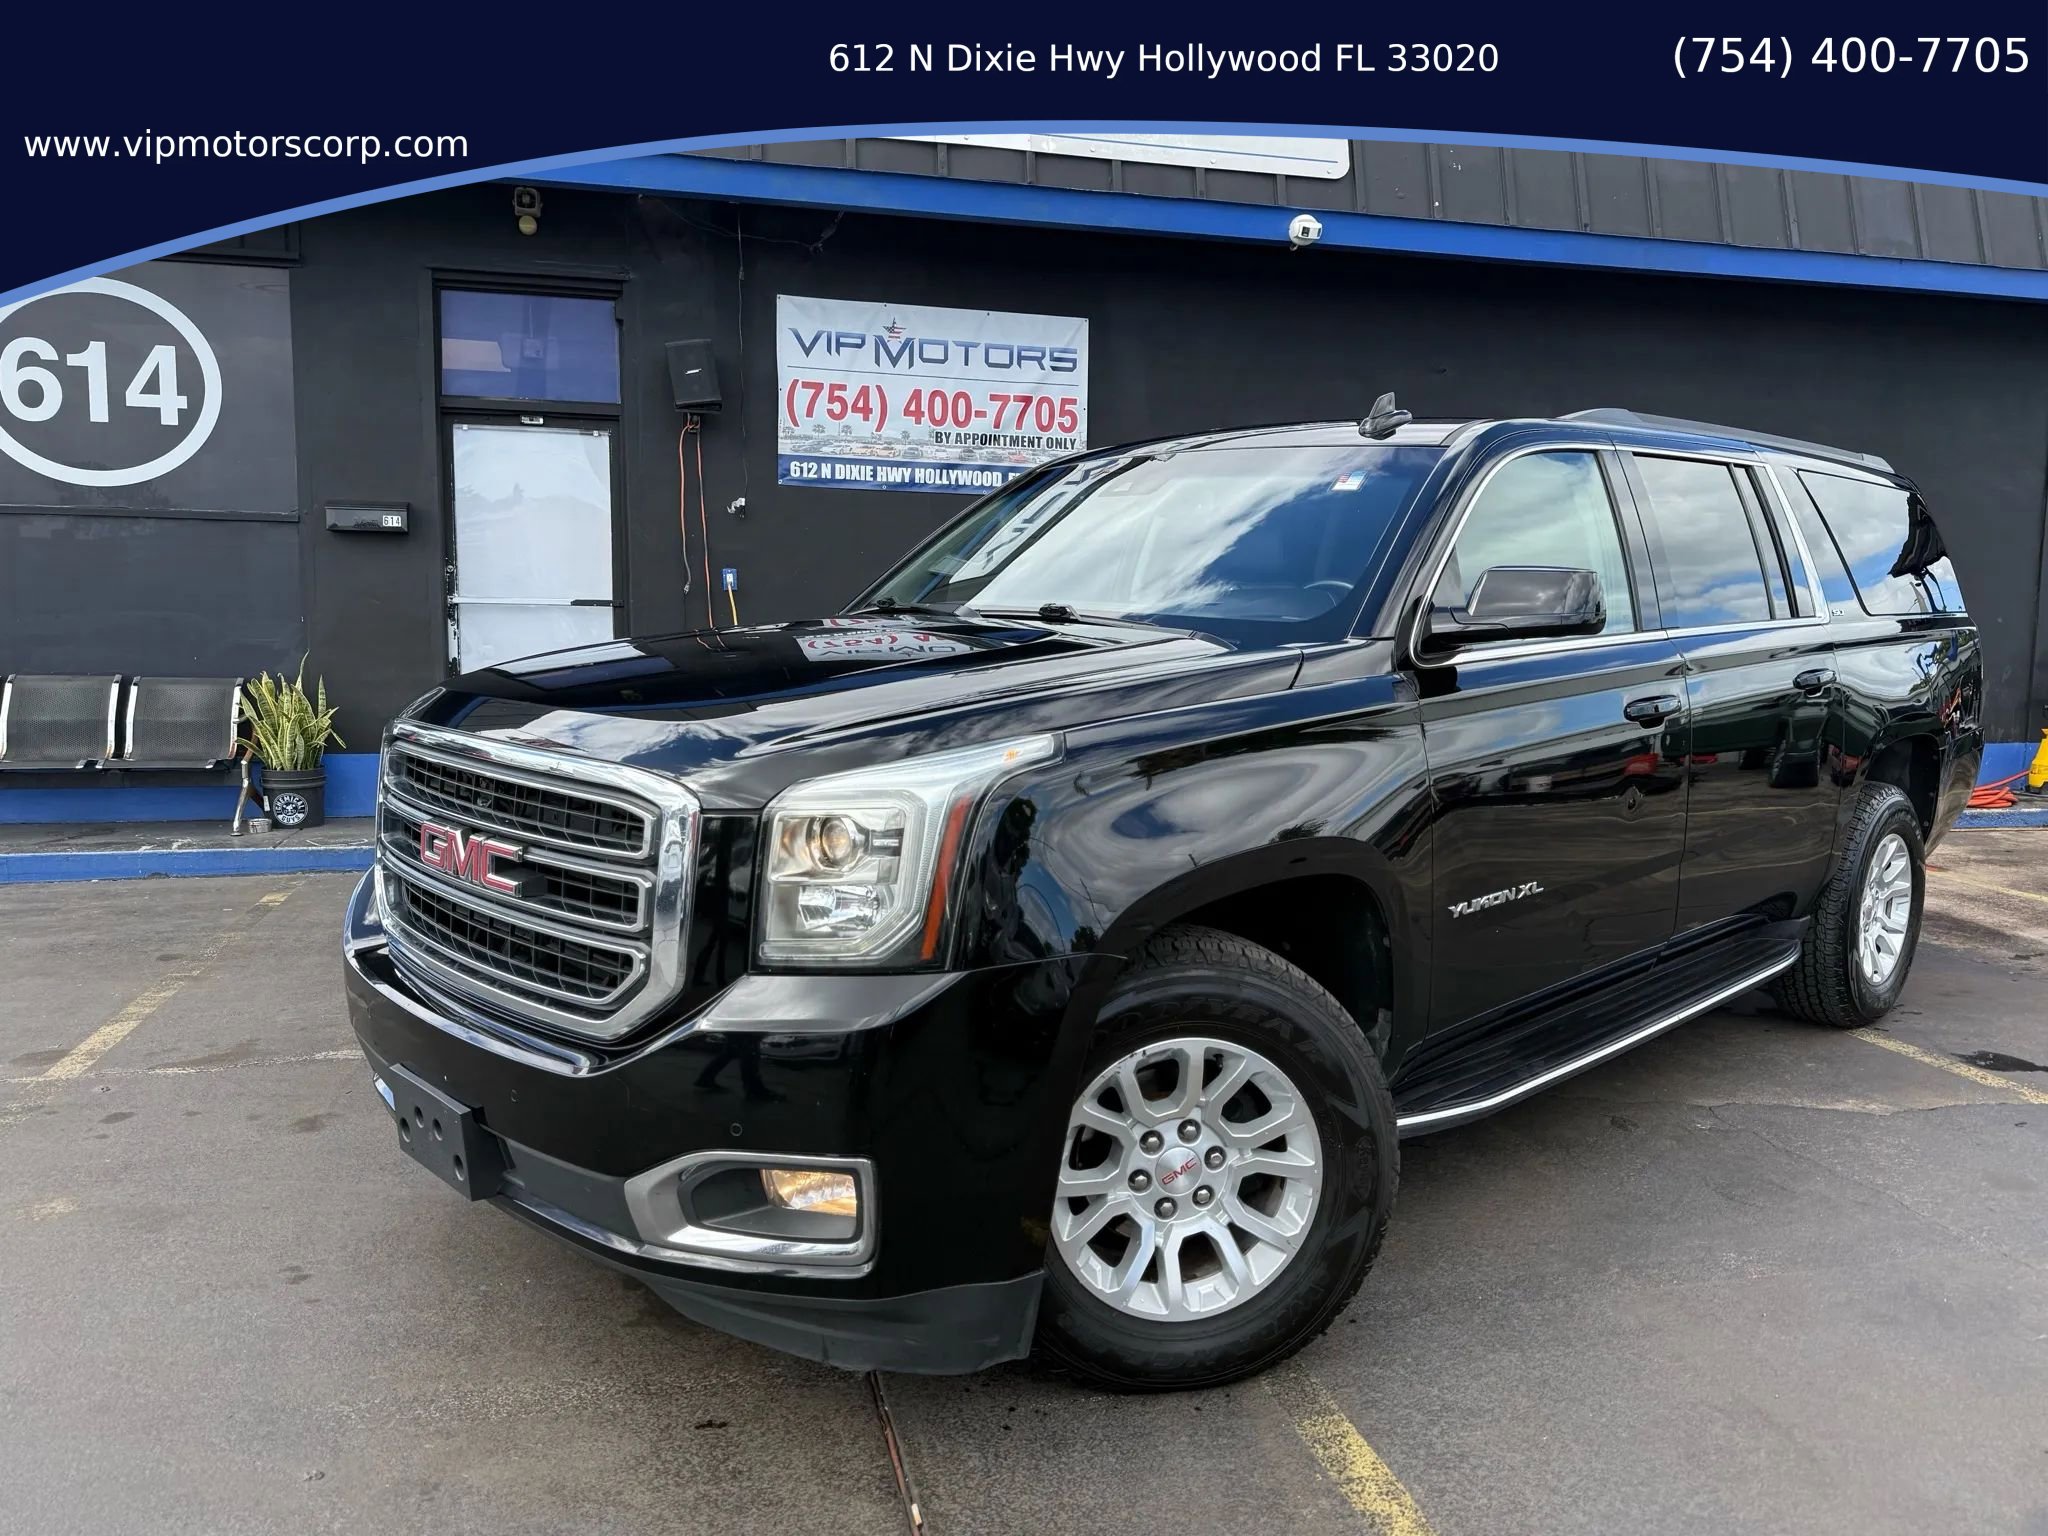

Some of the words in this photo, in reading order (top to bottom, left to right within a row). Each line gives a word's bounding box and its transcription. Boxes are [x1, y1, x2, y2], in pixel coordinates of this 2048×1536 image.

[788, 328, 866, 359] VIP
[873, 334, 1078, 372] MOTORS
[0, 337, 188, 425] 614
[786, 378, 888, 432] (754)
[903, 388, 1079, 434] 400-7705
[934, 431, 951, 445] BY
[955, 432, 1042, 449] APPOINTMENT
[1046, 436, 1077, 451] ONLY
[790, 461, 818, 478] 612
[821, 463, 832, 479] N
[835, 464, 874, 481] DIXIE
[877, 466, 911, 483] HWY
[915, 468, 1002, 487] HOLLYWOOD
[383, 516, 401, 526] 614
[281, 814, 301, 823] GUYS
[421, 821, 523, 897] GMC
[1448, 887, 1516, 919] YUKON
[1518, 881, 1544, 900] XL
[1162, 1157, 1197, 1185] GMC
